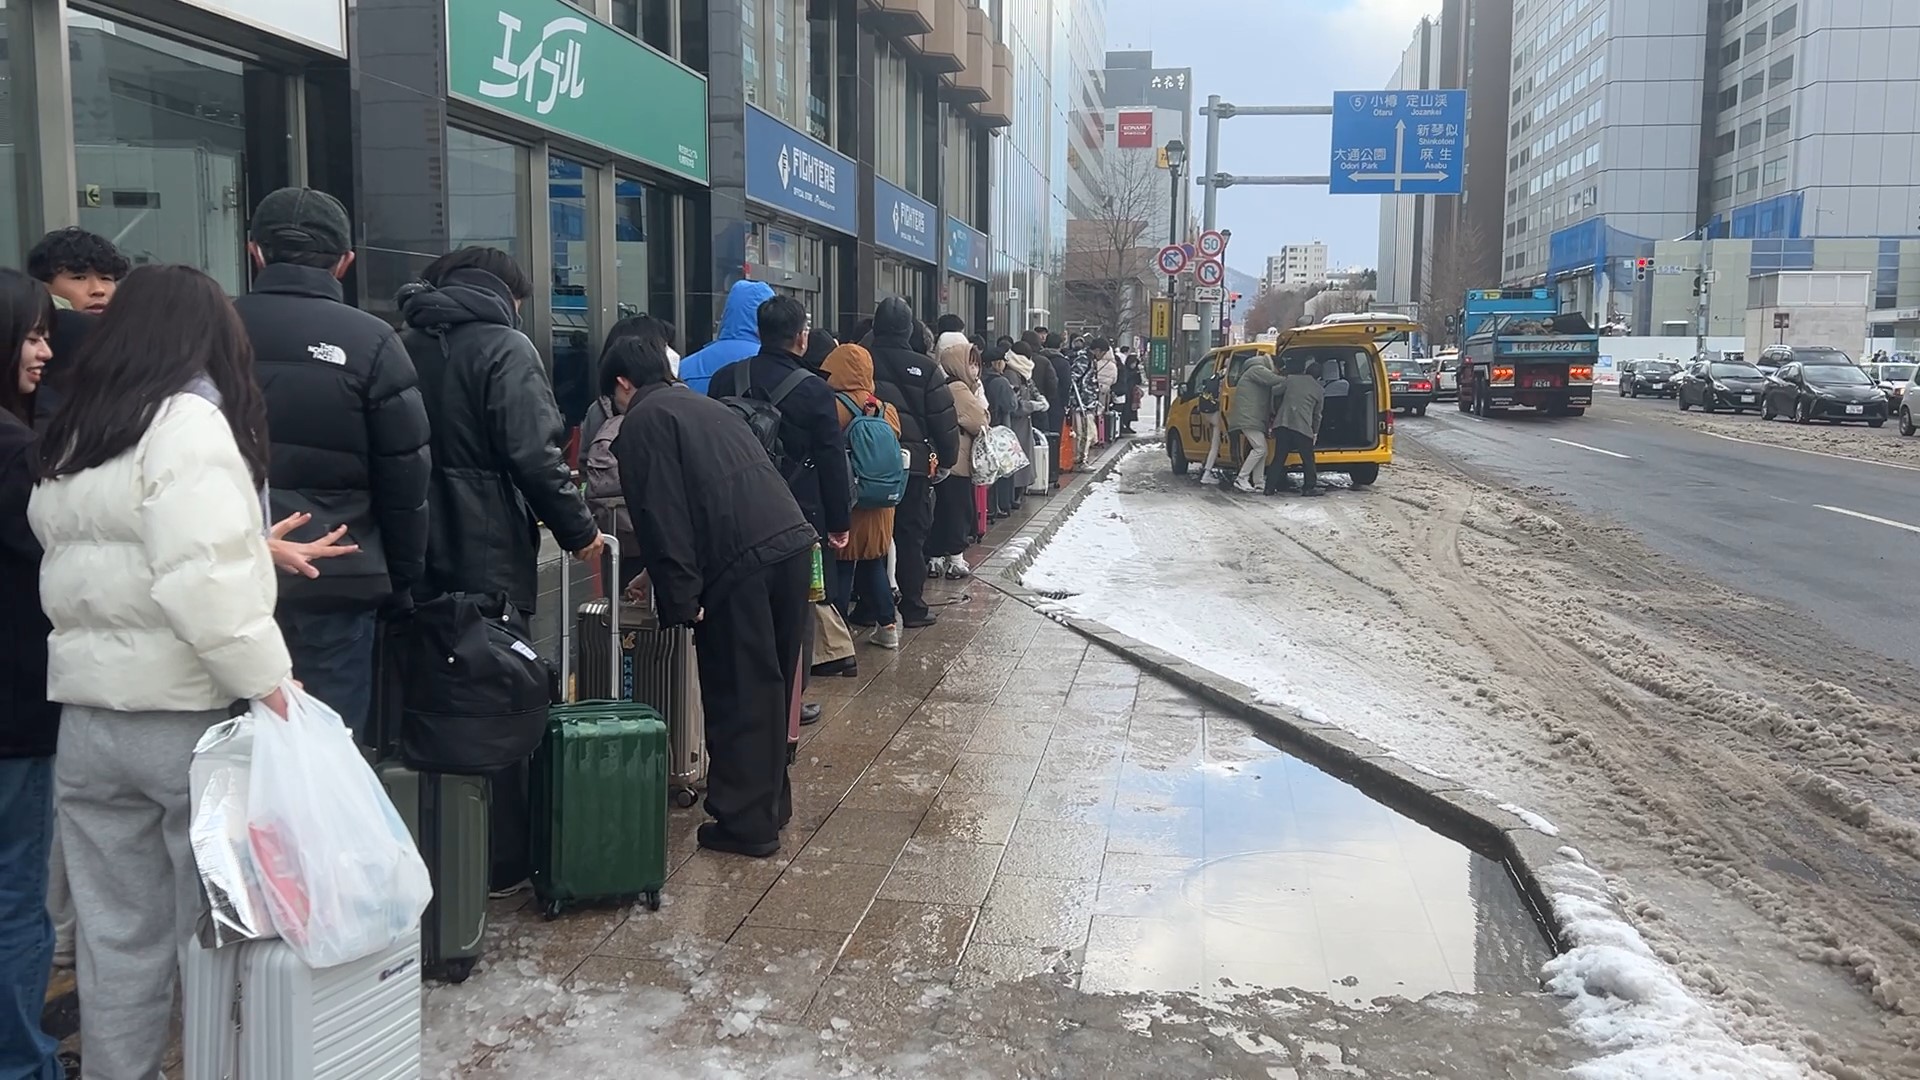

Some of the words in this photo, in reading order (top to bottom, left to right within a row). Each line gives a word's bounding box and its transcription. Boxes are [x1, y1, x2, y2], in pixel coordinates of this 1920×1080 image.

[479, 10, 587, 114] エイブル
[1354, 98, 1361, 107] 5
[1370, 95, 1398, 108] 小樽
[1406, 94, 1448, 108] 定山渓
[1417, 123, 1459, 137] 新琴似
[1333, 148, 1387, 161] 大通公園
[793, 147, 836, 194] FIGHTERS
[1203, 238, 1219, 251] 50
